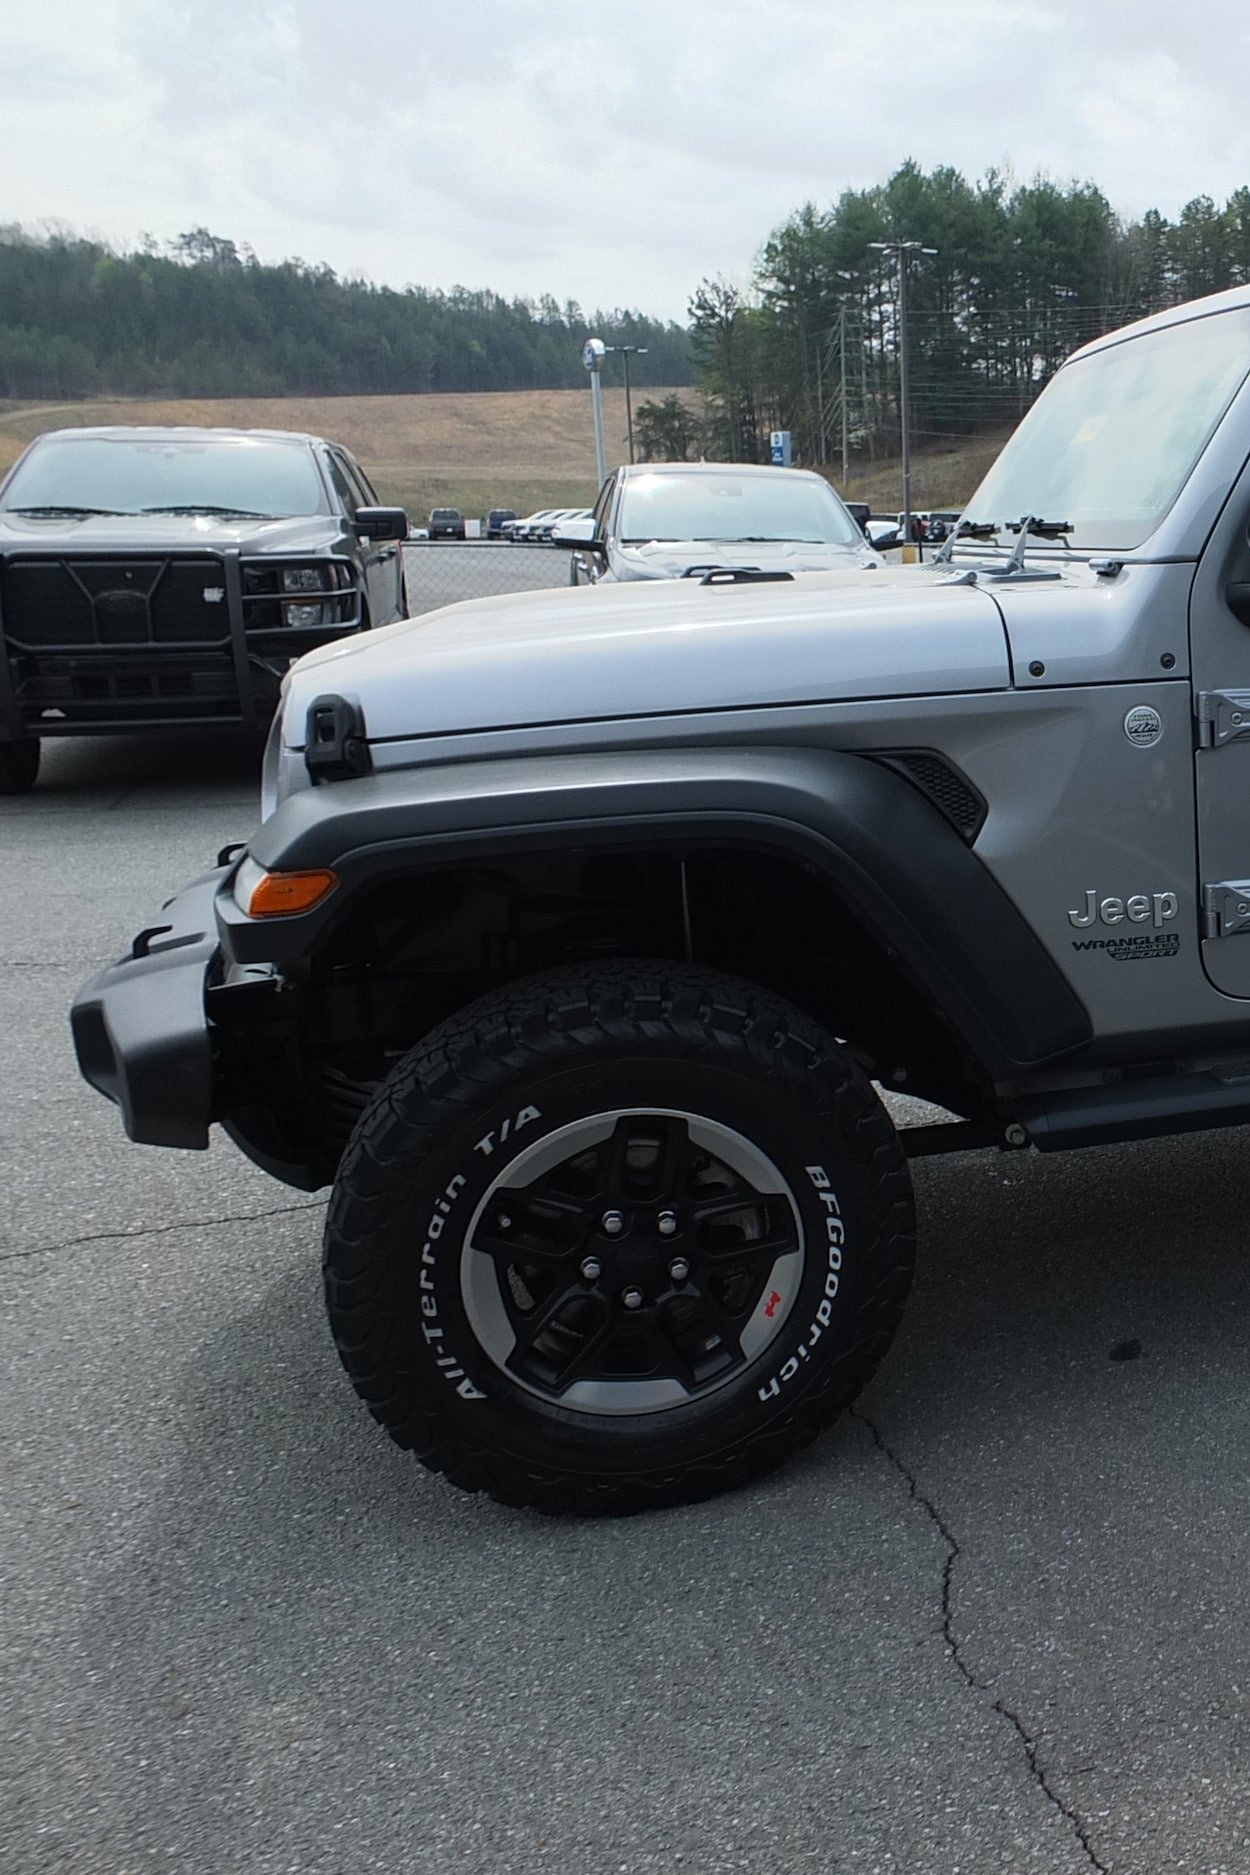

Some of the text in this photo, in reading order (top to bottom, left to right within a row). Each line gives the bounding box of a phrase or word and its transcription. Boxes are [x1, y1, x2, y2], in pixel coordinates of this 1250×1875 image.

[1068, 889, 1179, 928] Jeep
[1072, 933, 1180, 951] WRANGLER
[1106, 942, 1181, 953] UNLIMITED
[1111, 949, 1179, 961] SPORT
[420, 1103, 544, 1400] All-Terrain T/A
[757, 1164, 847, 1402] BFGoodrich
